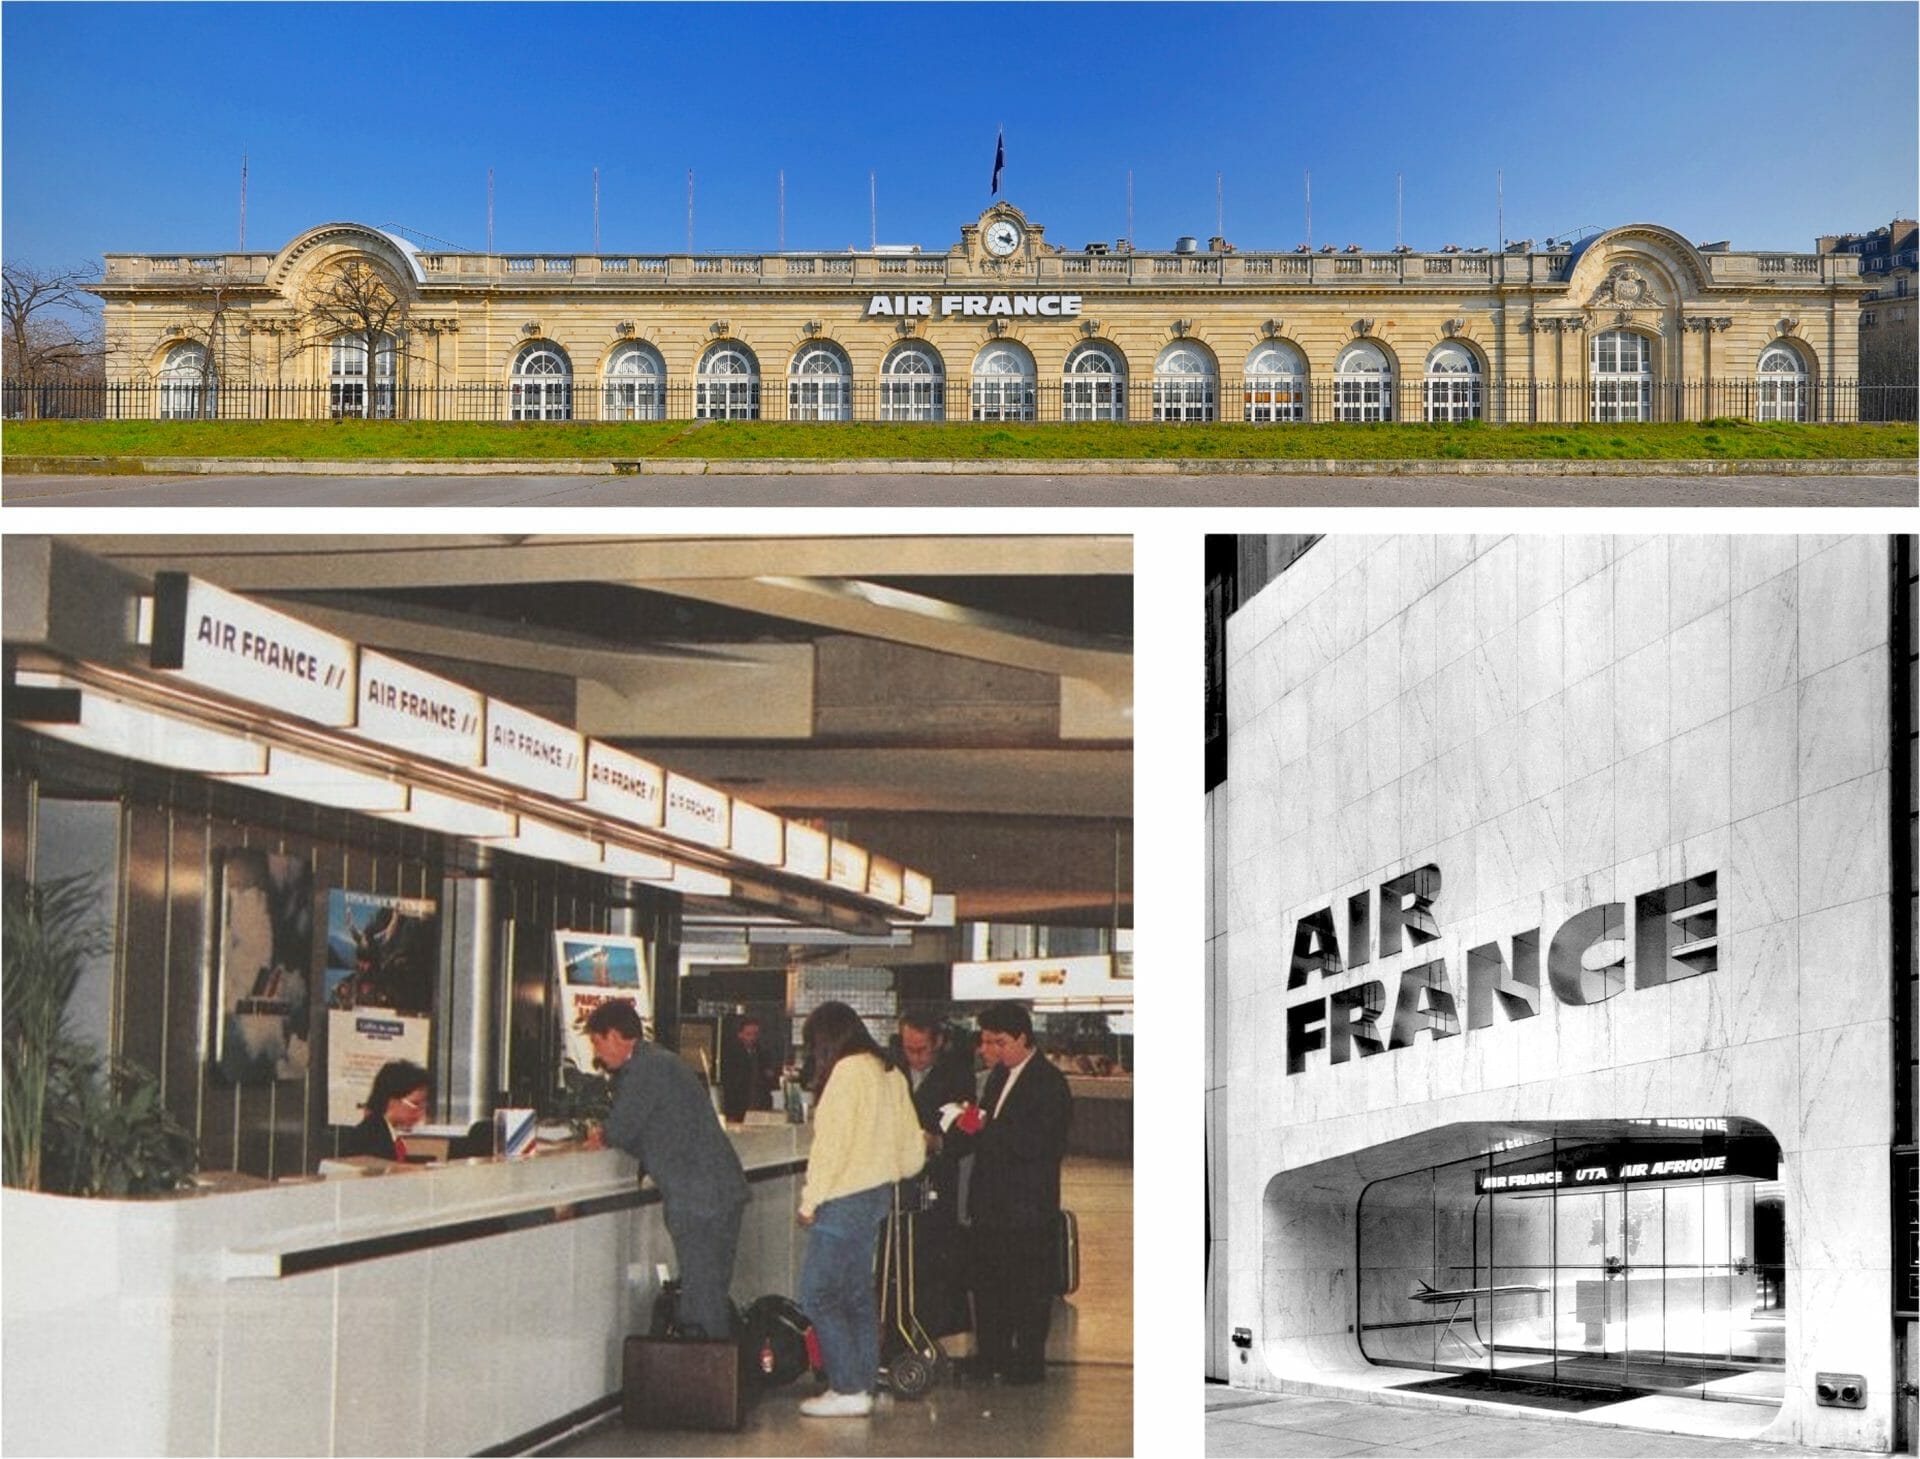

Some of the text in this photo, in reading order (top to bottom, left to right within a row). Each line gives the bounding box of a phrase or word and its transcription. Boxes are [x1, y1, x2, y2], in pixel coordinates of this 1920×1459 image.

[868, 295, 1082, 315] AIR FRANCE
[198, 615, 317, 681] AIR FRANCE
[368, 679, 456, 730] AIR FRANCE
[493, 724, 563, 768] AIR FRANCE
[1287, 863, 1442, 991] AIR
[1287, 870, 1718, 1076] FRANCE
[1483, 1155, 1728, 1188] AIR FRANCE UTA AIR AFRIQUE
